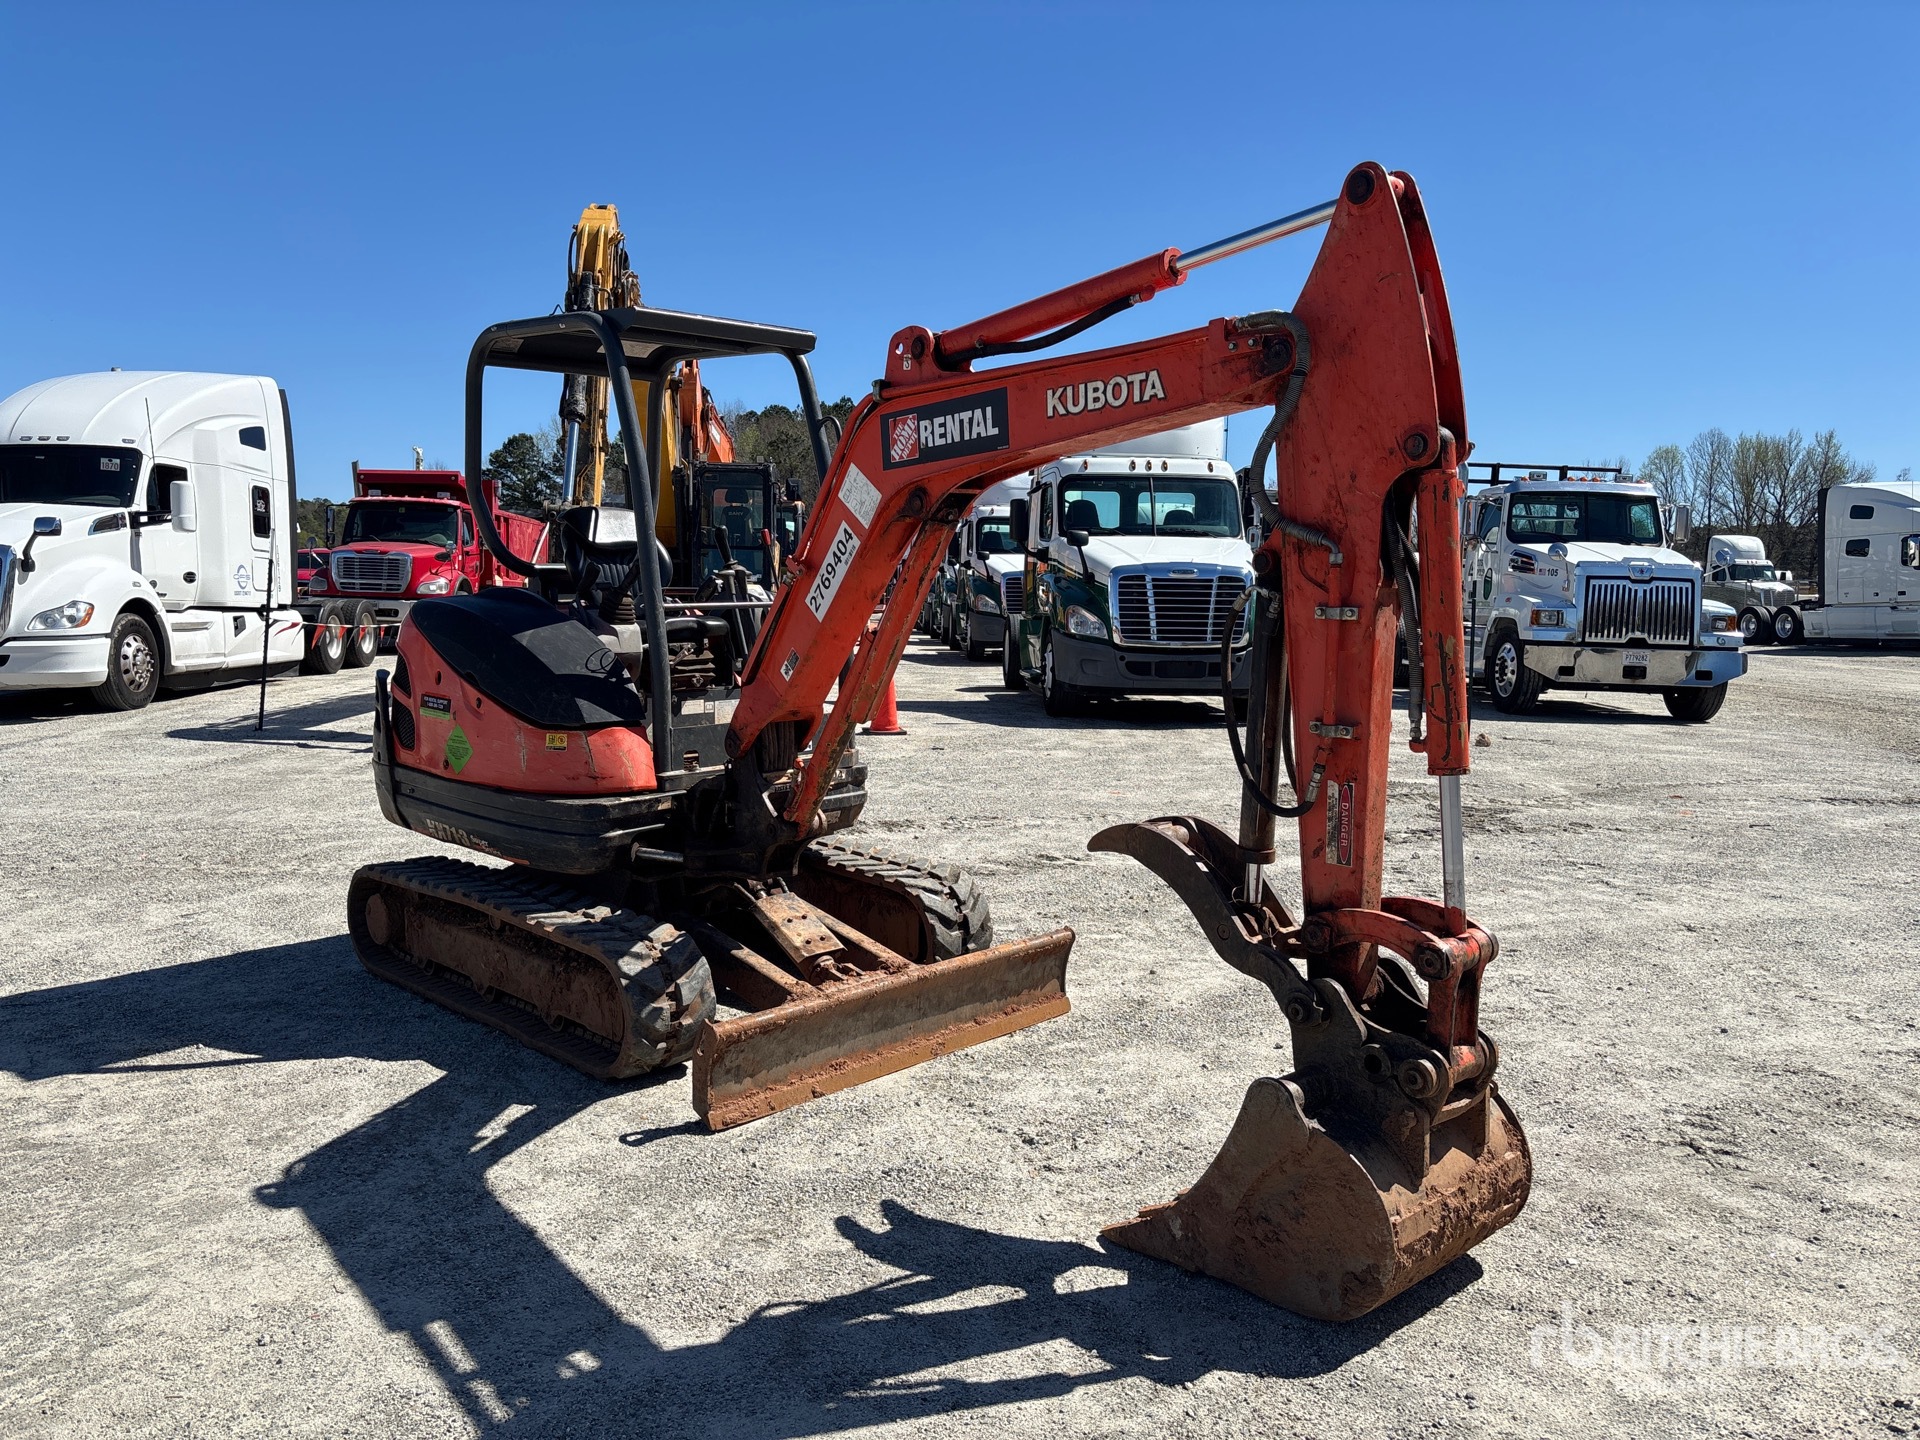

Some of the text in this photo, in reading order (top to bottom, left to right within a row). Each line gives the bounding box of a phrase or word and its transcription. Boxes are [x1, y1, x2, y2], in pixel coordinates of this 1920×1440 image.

[1046, 369, 1165, 418] KUBOTA
[891, 415, 918, 461] HOME
[893, 422, 904, 440] THE
[902, 430, 918, 460] DEPOT
[919, 406, 999, 449] RENTAL
[101, 462, 119, 470] 1870
[810, 527, 854, 614] 2769404
[1547, 568, 1559, 577] 105
[1341, 802, 1349, 846] DANGER
